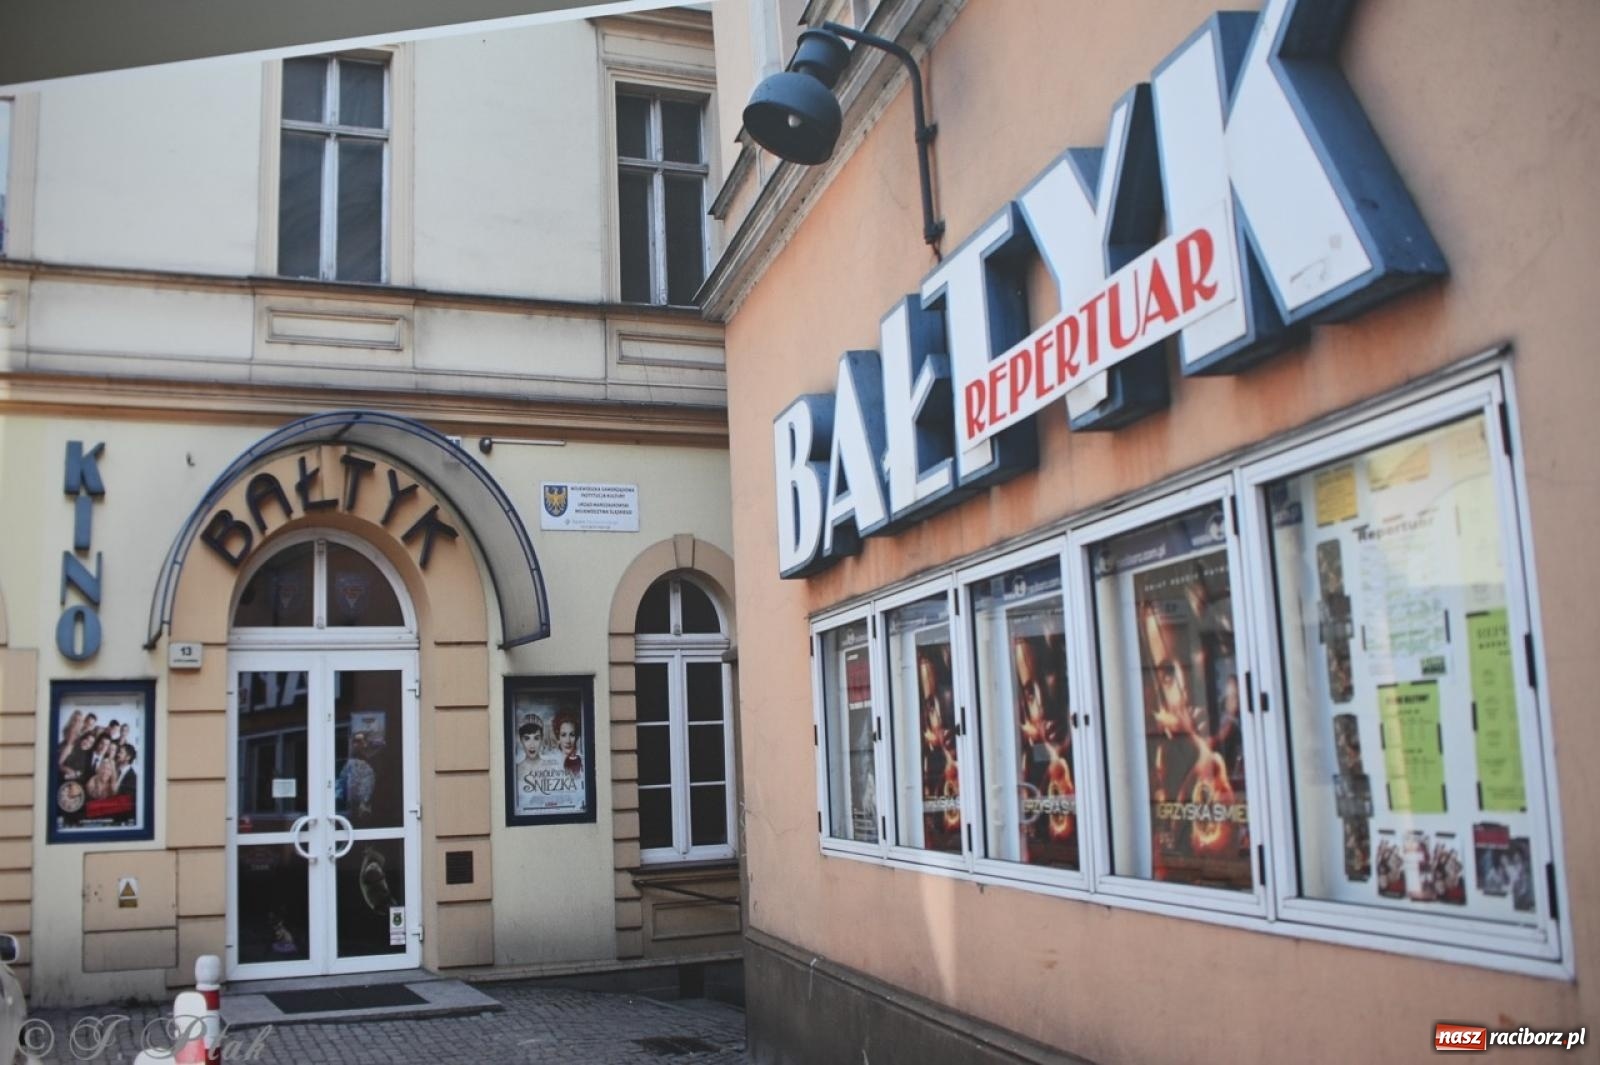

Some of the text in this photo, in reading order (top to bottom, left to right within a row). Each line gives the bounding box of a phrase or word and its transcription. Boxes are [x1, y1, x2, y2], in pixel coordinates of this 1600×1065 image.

[772, 0, 1430, 579] BAŁTYK
[964, 228, 1219, 440] REPERTUAR
[56, 440, 106, 662] KINO
[200, 455, 459, 569] BAŁTYK
[180, 645, 192, 656] 13
